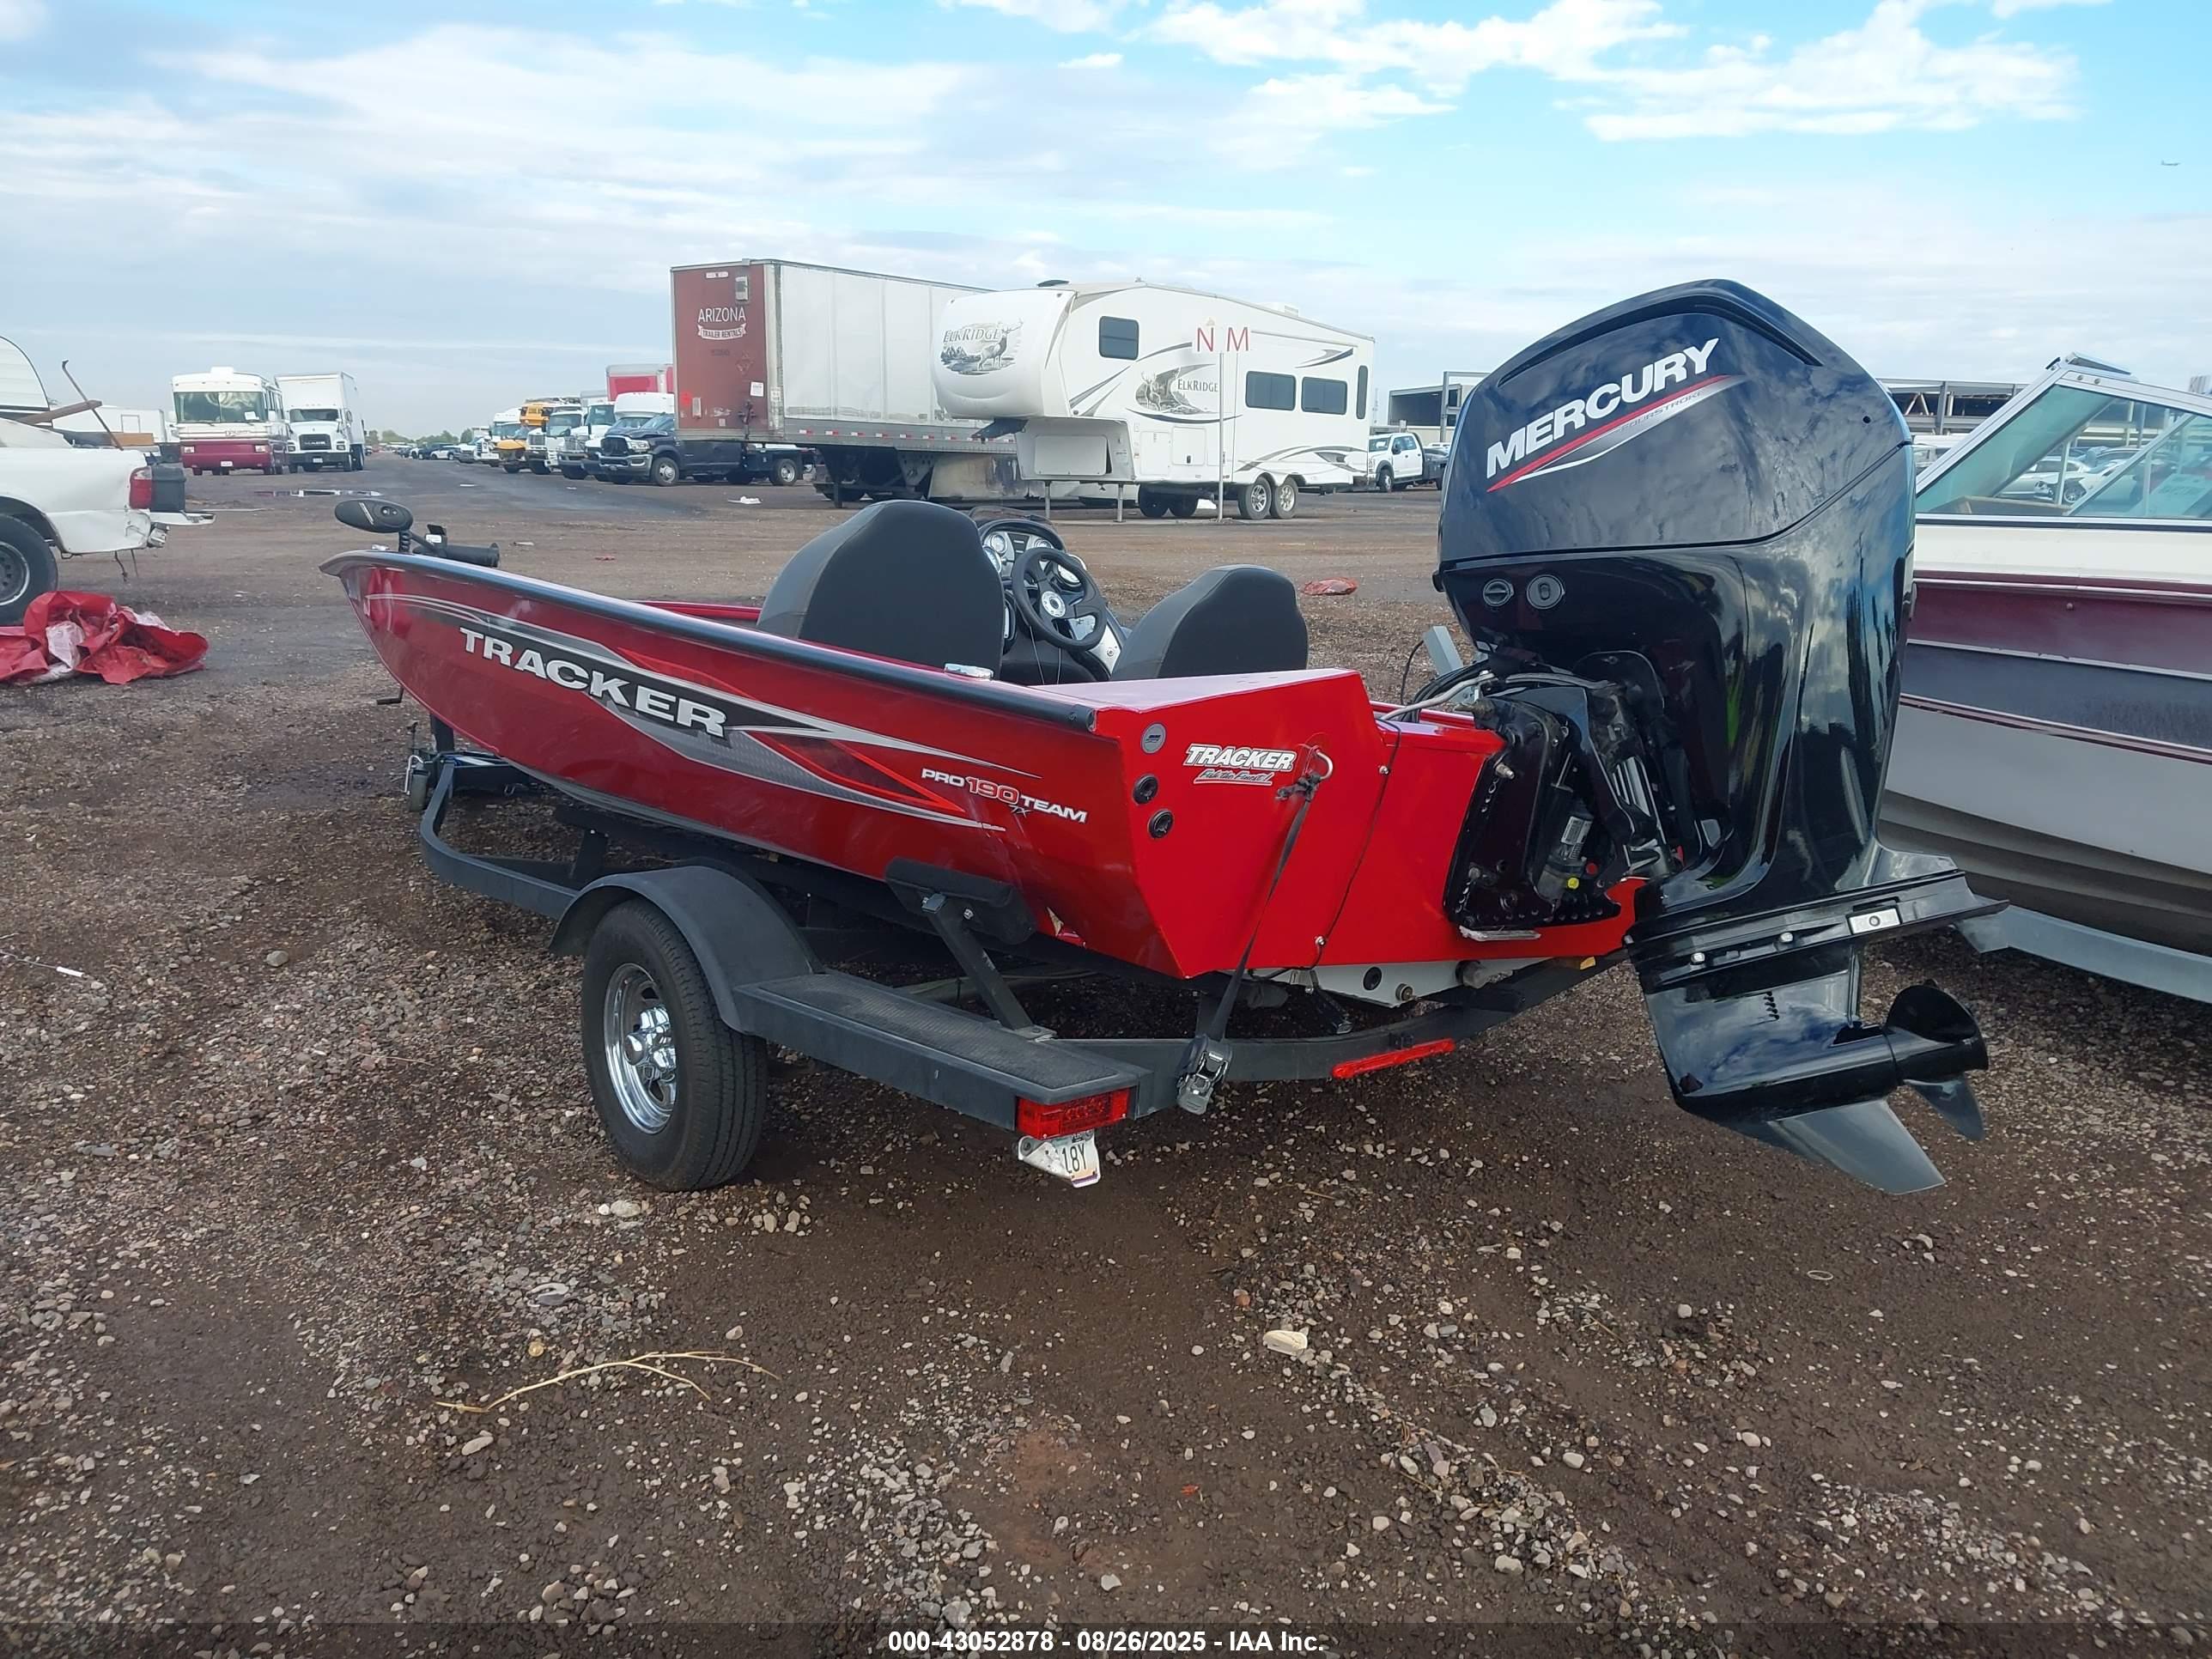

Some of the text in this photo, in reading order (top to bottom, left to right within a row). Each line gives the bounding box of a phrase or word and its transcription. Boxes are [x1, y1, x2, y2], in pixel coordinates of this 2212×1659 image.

[697, 307, 746, 323] ARIZONA
[721, 328, 743, 338] RENTALS
[1197, 326, 1249, 352] N M
[1486, 337, 1720, 479] MERCURY
[459, 627, 728, 738] TRACKER
[1185, 744, 1296, 771] TRACKER
[921, 768, 1089, 824] PRO 190 TEAM
